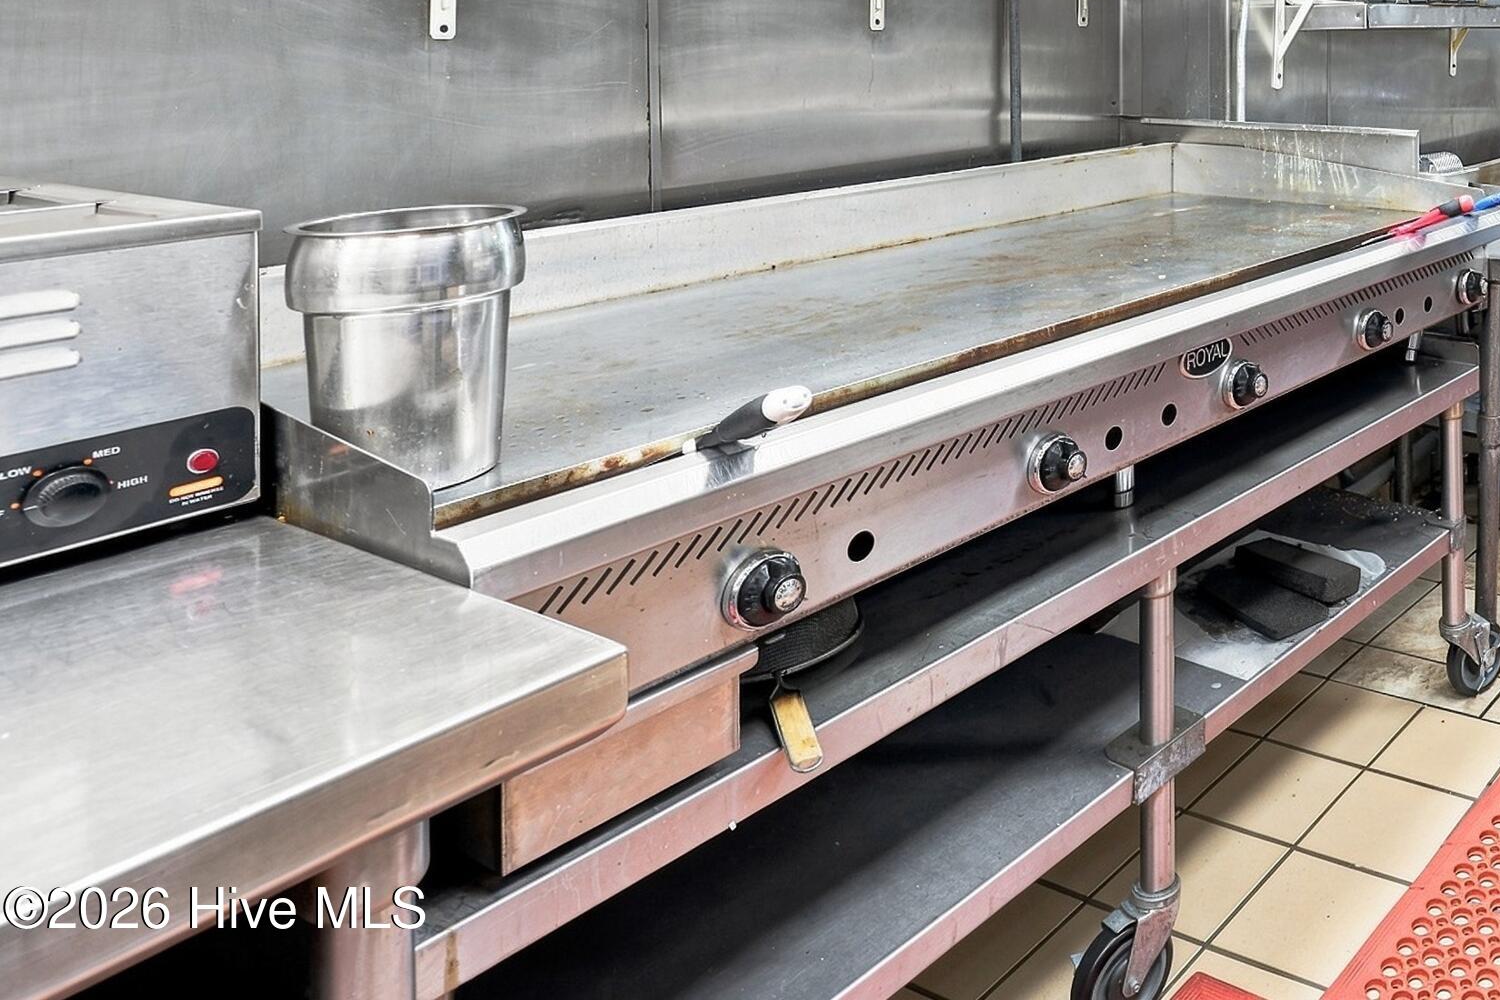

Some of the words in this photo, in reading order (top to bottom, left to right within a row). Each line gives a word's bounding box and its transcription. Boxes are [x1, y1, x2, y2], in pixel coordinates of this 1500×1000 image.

[1186, 341, 1228, 371] ROYAL
[92, 446, 121, 459] MED
[117, 475, 148, 489] HIGH
